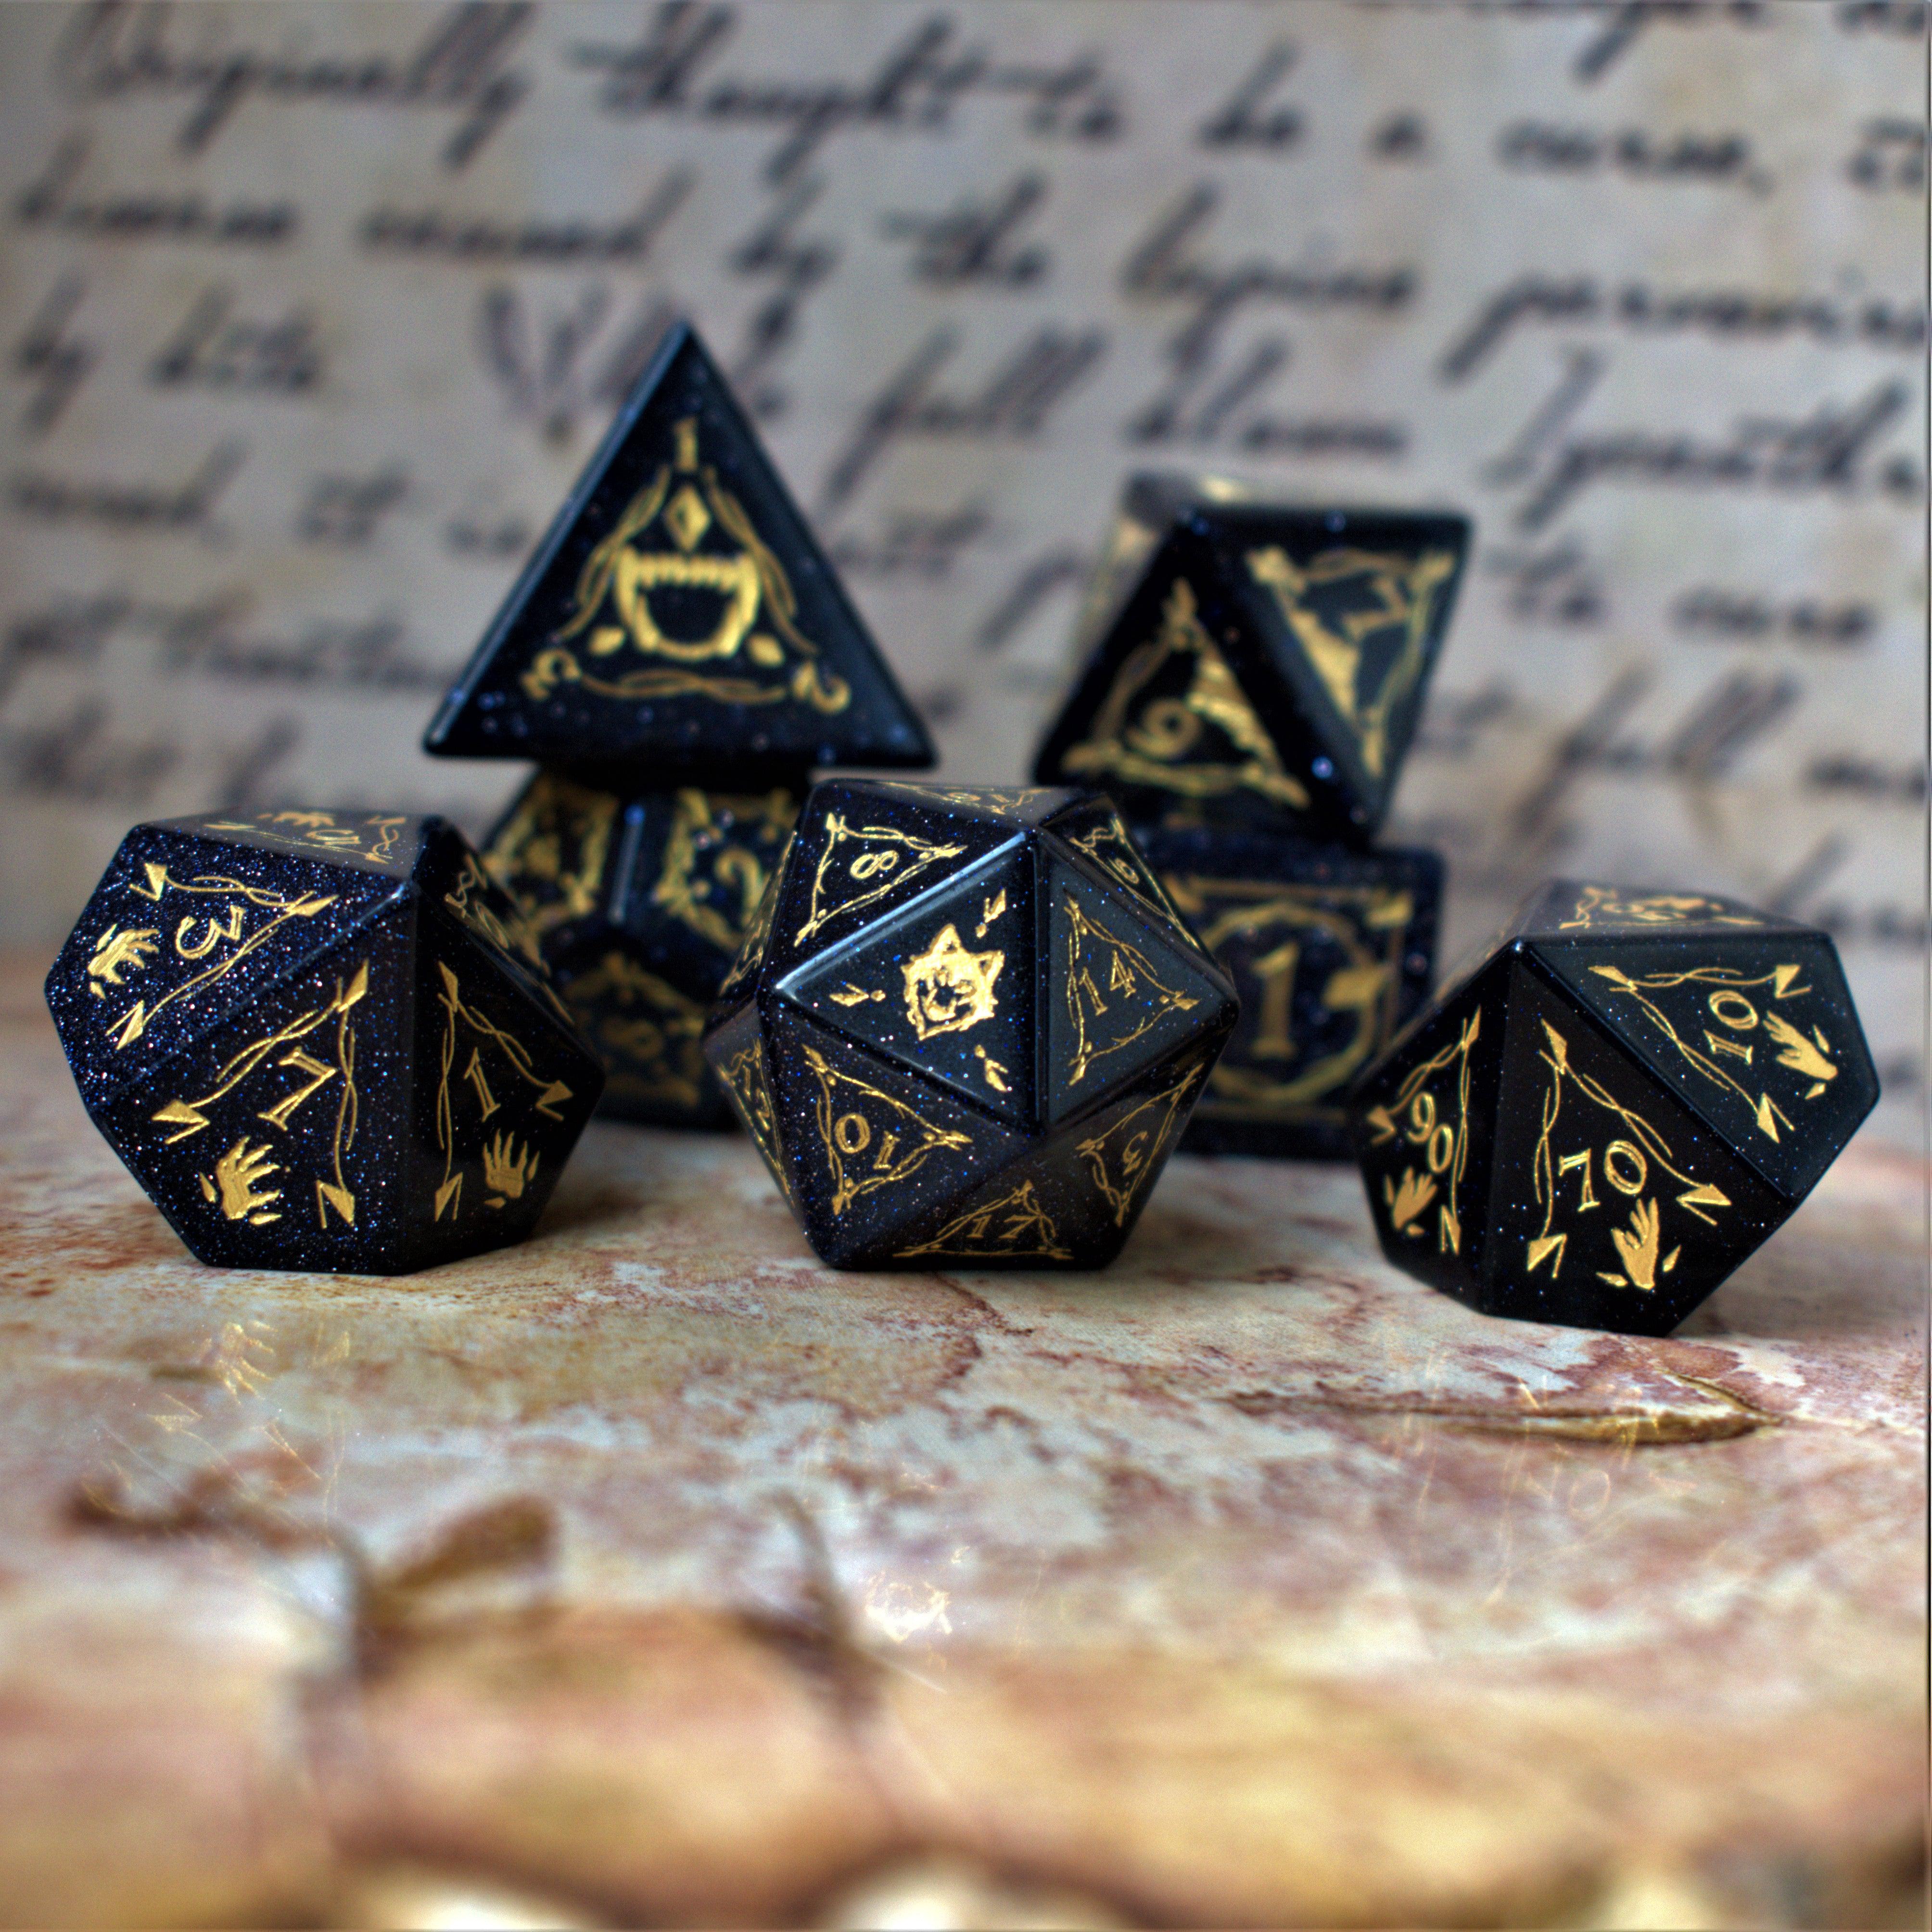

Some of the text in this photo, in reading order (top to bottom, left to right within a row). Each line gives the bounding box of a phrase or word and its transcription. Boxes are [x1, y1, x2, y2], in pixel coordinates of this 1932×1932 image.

[850, 850, 900, 880] 8
[175, 905, 244, 960] 3
[1078, 949, 1139, 1016] 14
[1251, 941, 1297, 1057] 1
[1703, 990, 1758, 1066] 10
[257, 1047, 338, 1132] 7
[464, 1047, 501, 1123] 1
[833, 1113, 901, 1170] 10
[1410, 1091, 1454, 1173] 90
[1559, 1139, 1648, 1213] 70
[967, 1213, 1039, 1240] 17
